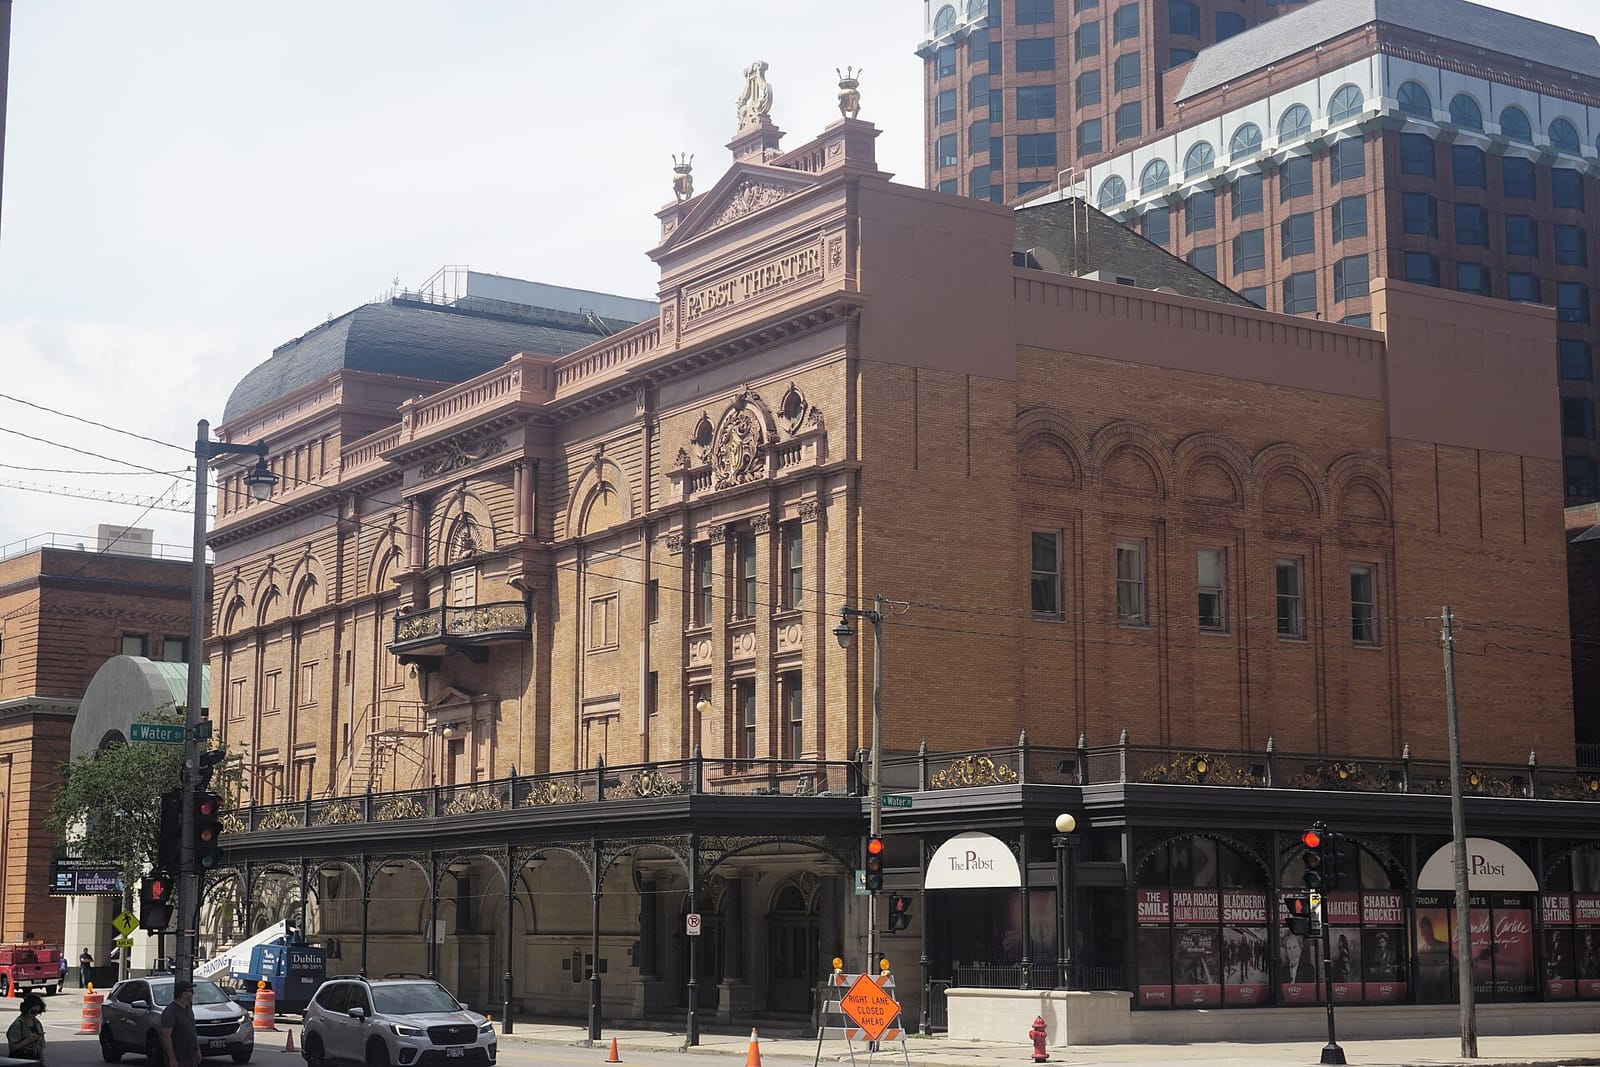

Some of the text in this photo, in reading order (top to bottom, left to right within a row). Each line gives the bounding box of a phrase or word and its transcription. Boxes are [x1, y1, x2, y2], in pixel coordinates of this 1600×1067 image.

[686, 249, 821, 321] PABST THEATER
[132, 729, 138, 737] N
[140, 726, 172, 739] Water
[888, 797, 905, 806] Water
[948, 850, 994, 871] The Pabst
[1471, 855, 1505, 876] Pabst
[1146, 892, 1161, 902] THE
[1173, 893, 1218, 906] PAPA ROACH
[1223, 895, 1266, 908] BLACKBERRY
[1363, 896, 1400, 908] CHARLEY
[1481, 897, 1486, 905] 5
[1542, 897, 1557, 908] IVE
[1138, 902, 1169, 915] SMILE
[1576, 900, 1594, 908] JOHN
[1224, 909, 1266, 920] SMOKE
[1364, 909, 1401, 921] CROCKETT
[1543, 909, 1570, 921] GHTING
[293, 954, 322, 963] Dublin
[849, 995, 889, 1005] RIGHT LANE
[857, 1007, 884, 1015] CLOSED
[862, 1018, 884, 1026] AHEAD
